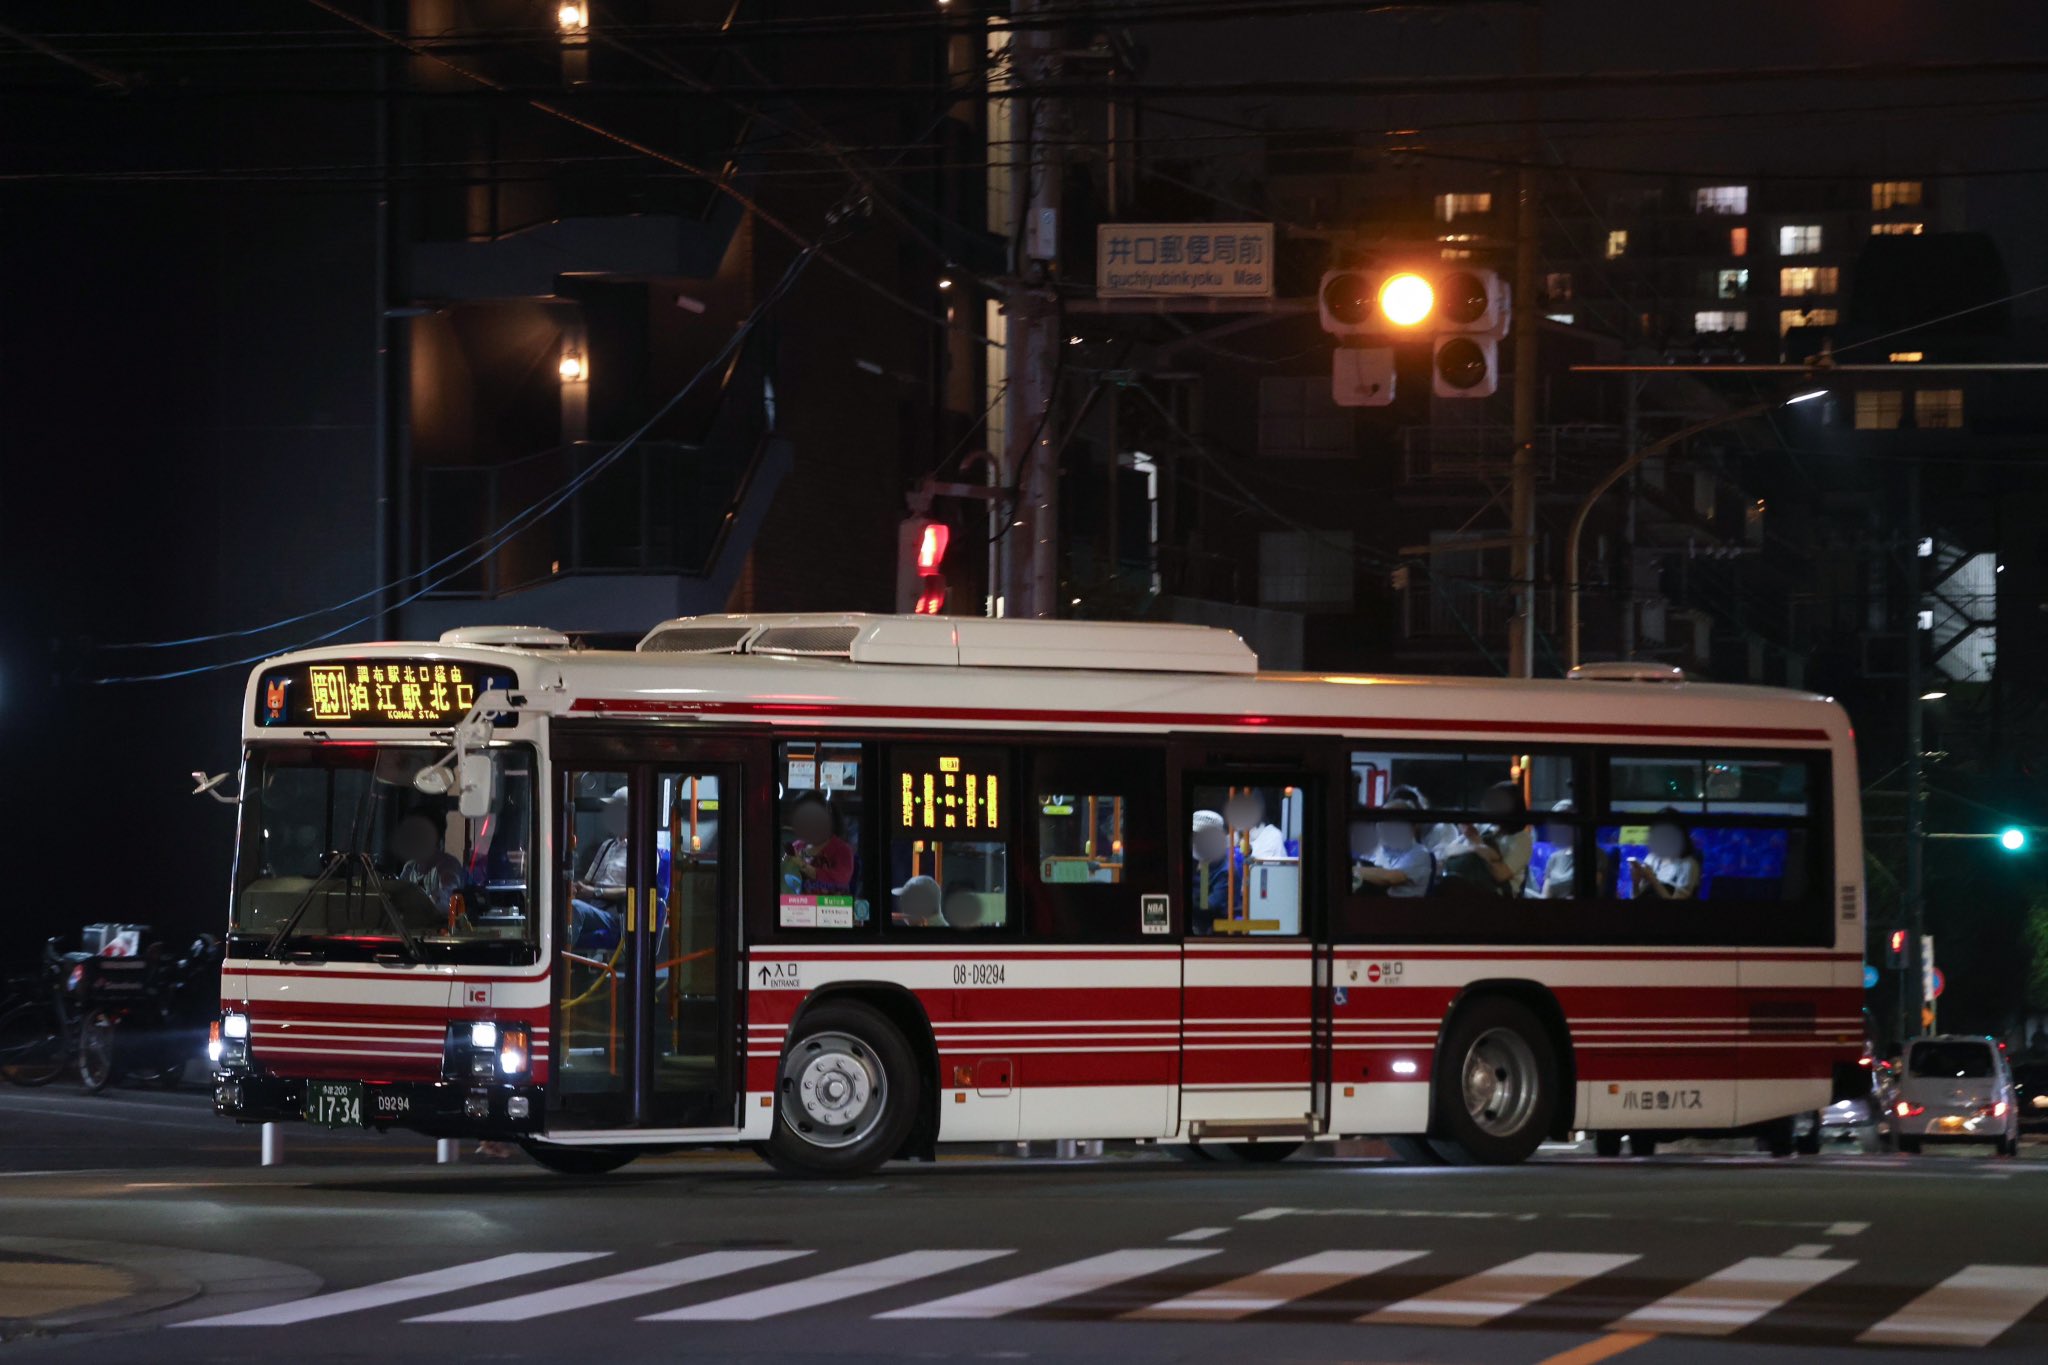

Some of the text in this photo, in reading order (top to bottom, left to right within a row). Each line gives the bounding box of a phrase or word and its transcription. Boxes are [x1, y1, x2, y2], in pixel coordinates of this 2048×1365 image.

[1108, 235, 1263, 264] 井口郵便局前
[1107, 270, 1263, 288] Iguchiyubinkyoku Mae
[357, 665, 462, 683] 調布駅北口経由
[312, 671, 347, 714] 境91
[348, 682, 474, 711] 狛江駅北口
[387, 710, 440, 720] KOMAE STA.
[774, 963, 798, 977] 入口
[953, 964, 1005, 985] 08-D9294
[1382, 961, 1403, 975] 出口
[770, 978, 800, 988] ENTRANCE
[378, 1096, 410, 1111] D9294
[1622, 1090, 1703, 1110] 小田急バス
[319, 1096, 360, 1124] 17-34
